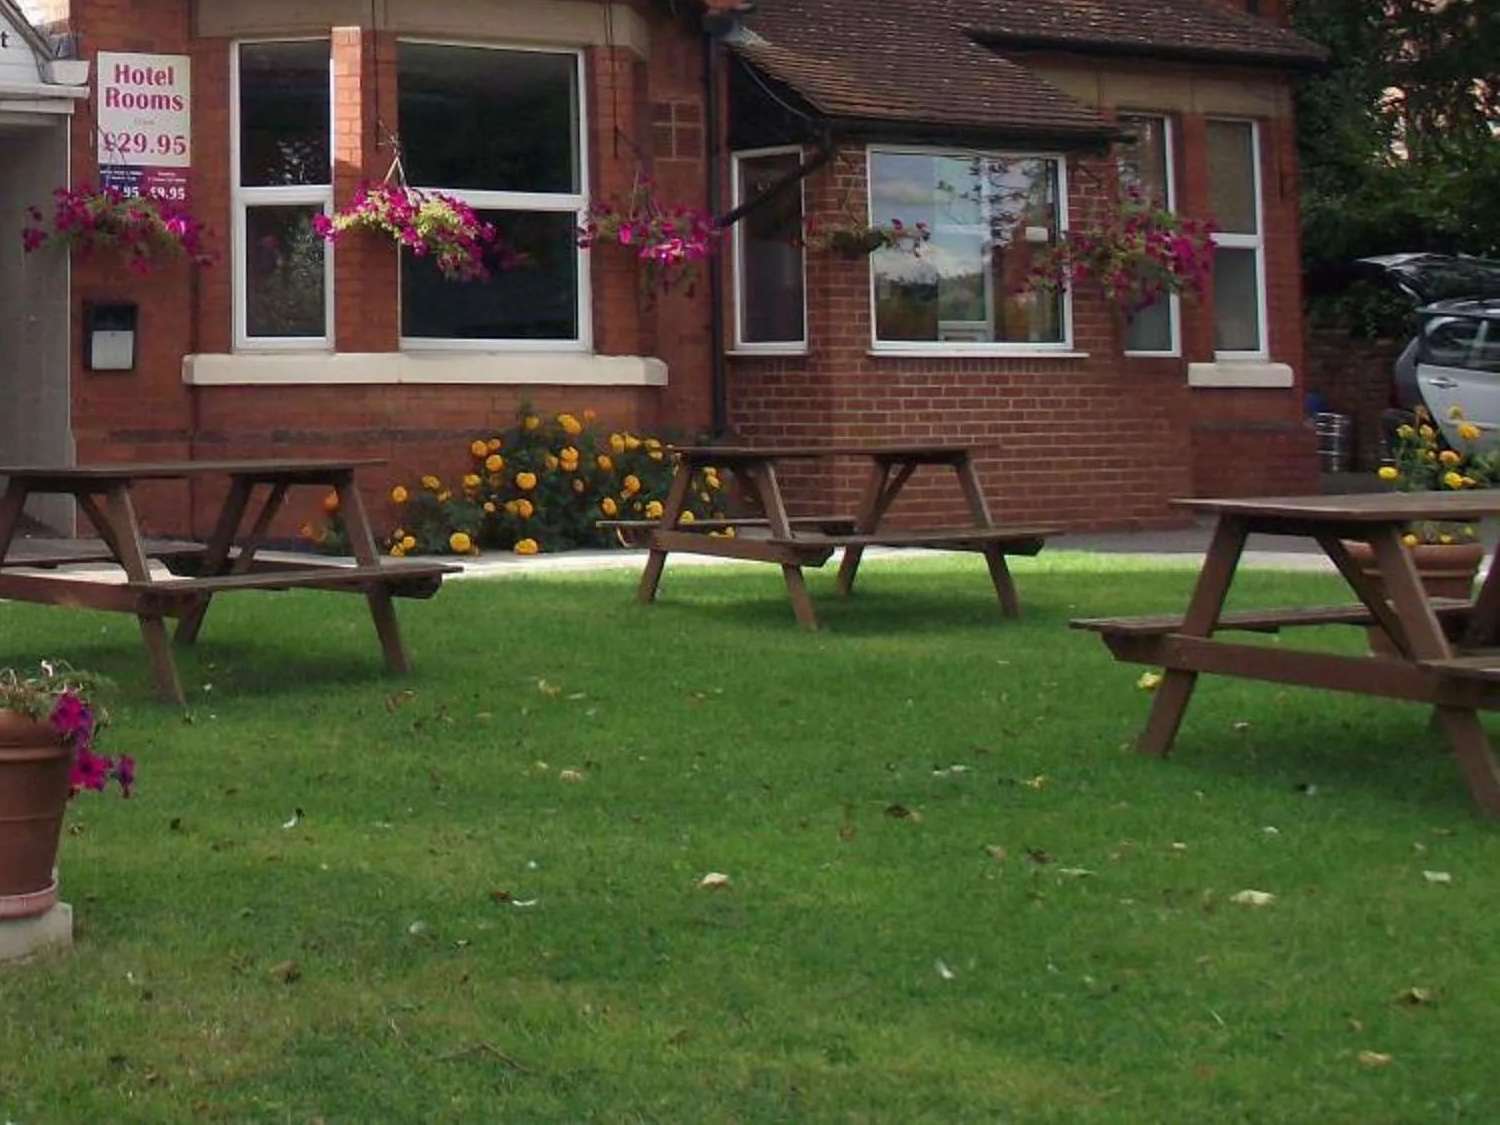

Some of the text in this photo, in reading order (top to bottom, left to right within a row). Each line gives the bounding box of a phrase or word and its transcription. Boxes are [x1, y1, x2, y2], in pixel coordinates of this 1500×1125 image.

[114, 63, 175, 87] Hotel
[105, 86, 184, 112] Rooms
[103, 131, 187, 156] £29.95
